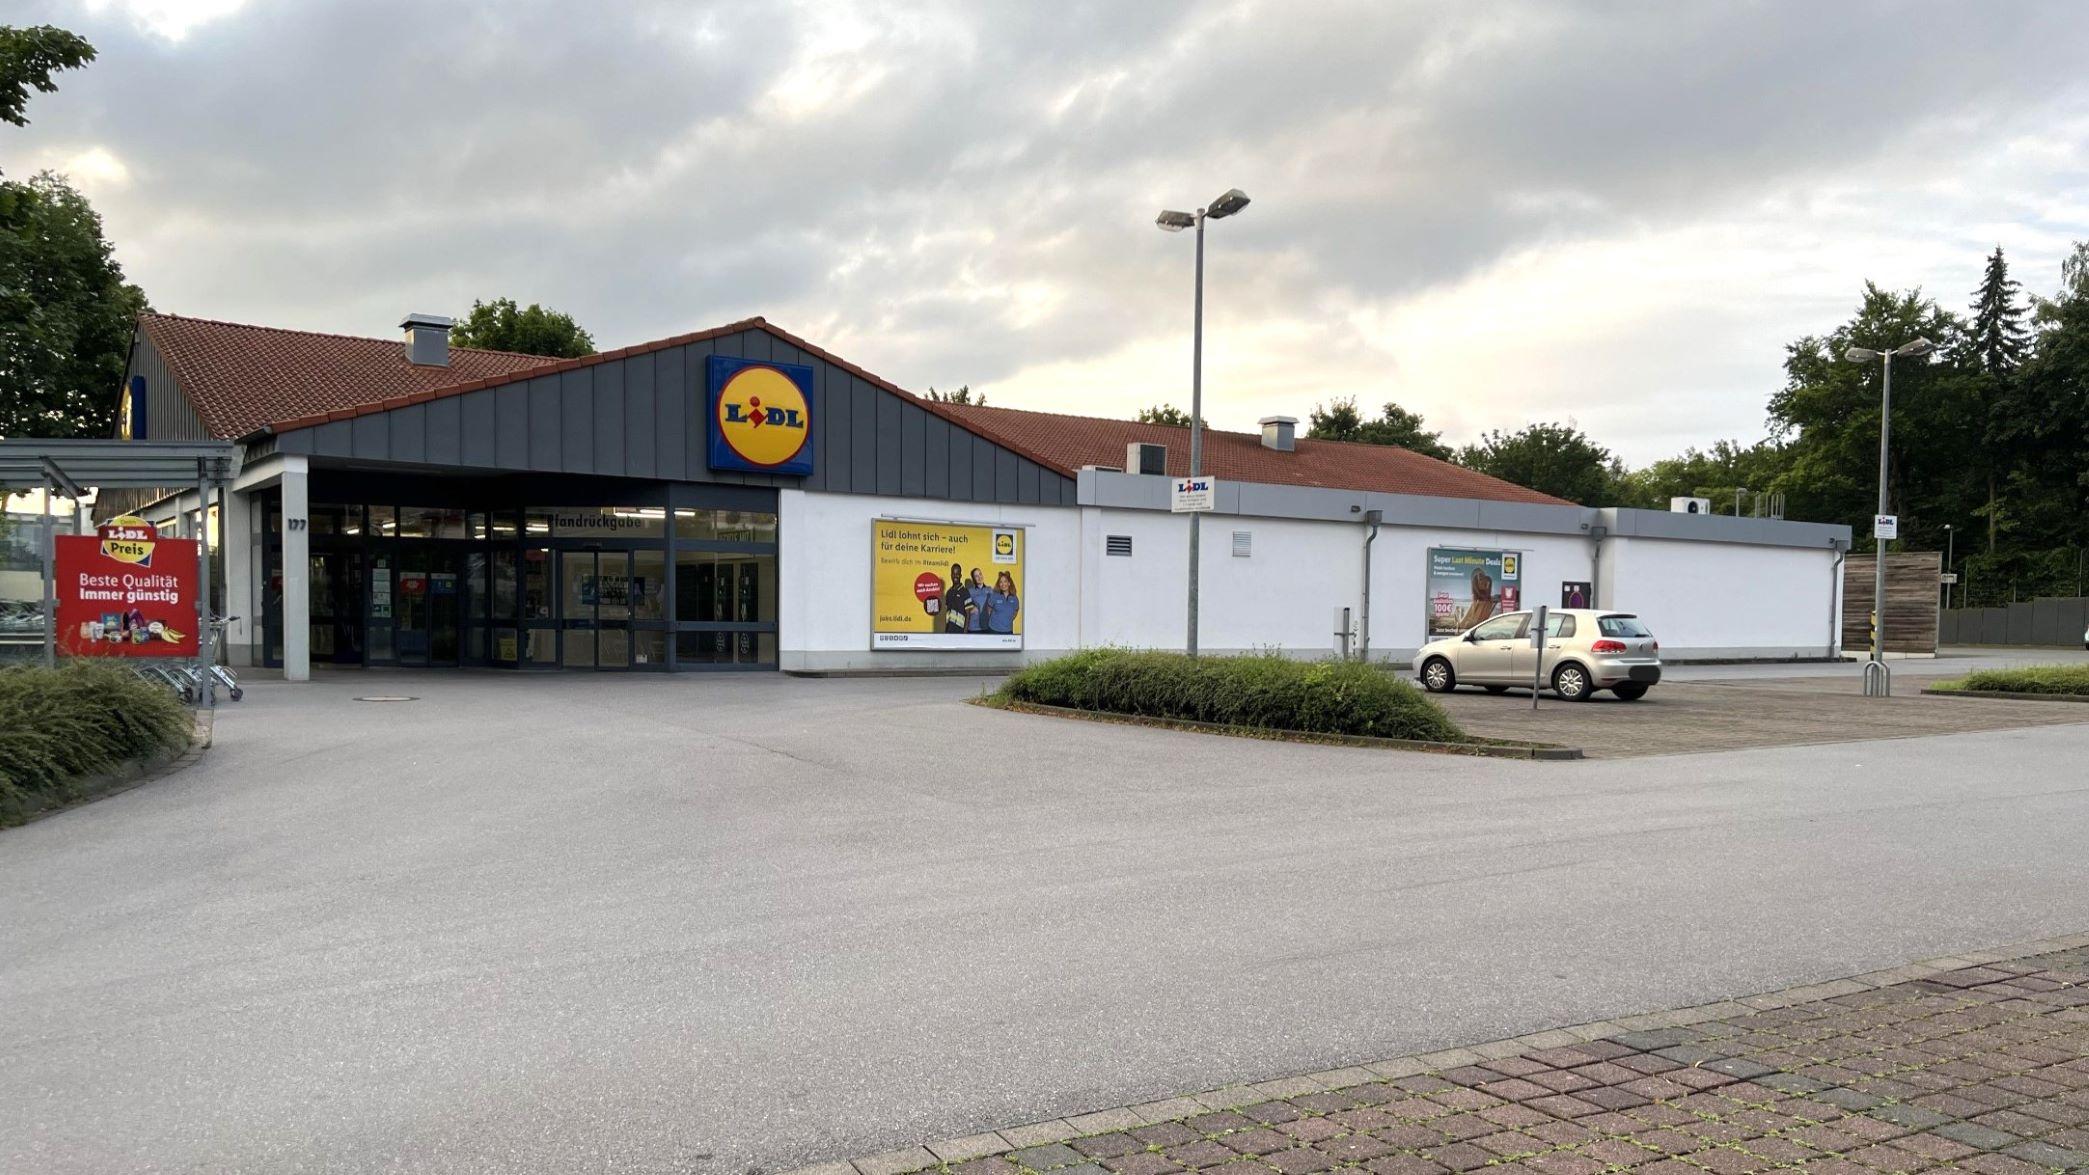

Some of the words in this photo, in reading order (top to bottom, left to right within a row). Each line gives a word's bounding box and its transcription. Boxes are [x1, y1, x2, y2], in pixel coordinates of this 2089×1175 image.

[725, 396, 804, 429] LIDL
[1178, 479, 1208, 494] LIDL
[288, 518, 307, 531] 177
[547, 513, 641, 531] Pfandrückgabe
[108, 527, 148, 540] LIDL
[881, 530, 897, 539] Lidl
[899, 530, 921, 540] lohnt
[923, 532, 940, 541] sich
[948, 534, 968, 544] auch
[111, 543, 144, 555] Preis
[881, 542, 893, 550] für
[895, 542, 919, 551] deine
[920, 544, 956, 554] Karriere!
[80, 573, 118, 587] Beste
[122, 573, 178, 588] Qualität
[80, 588, 124, 601] Immer
[126, 589, 179, 604] günstig
[1434, 604, 1452, 612] 100€
